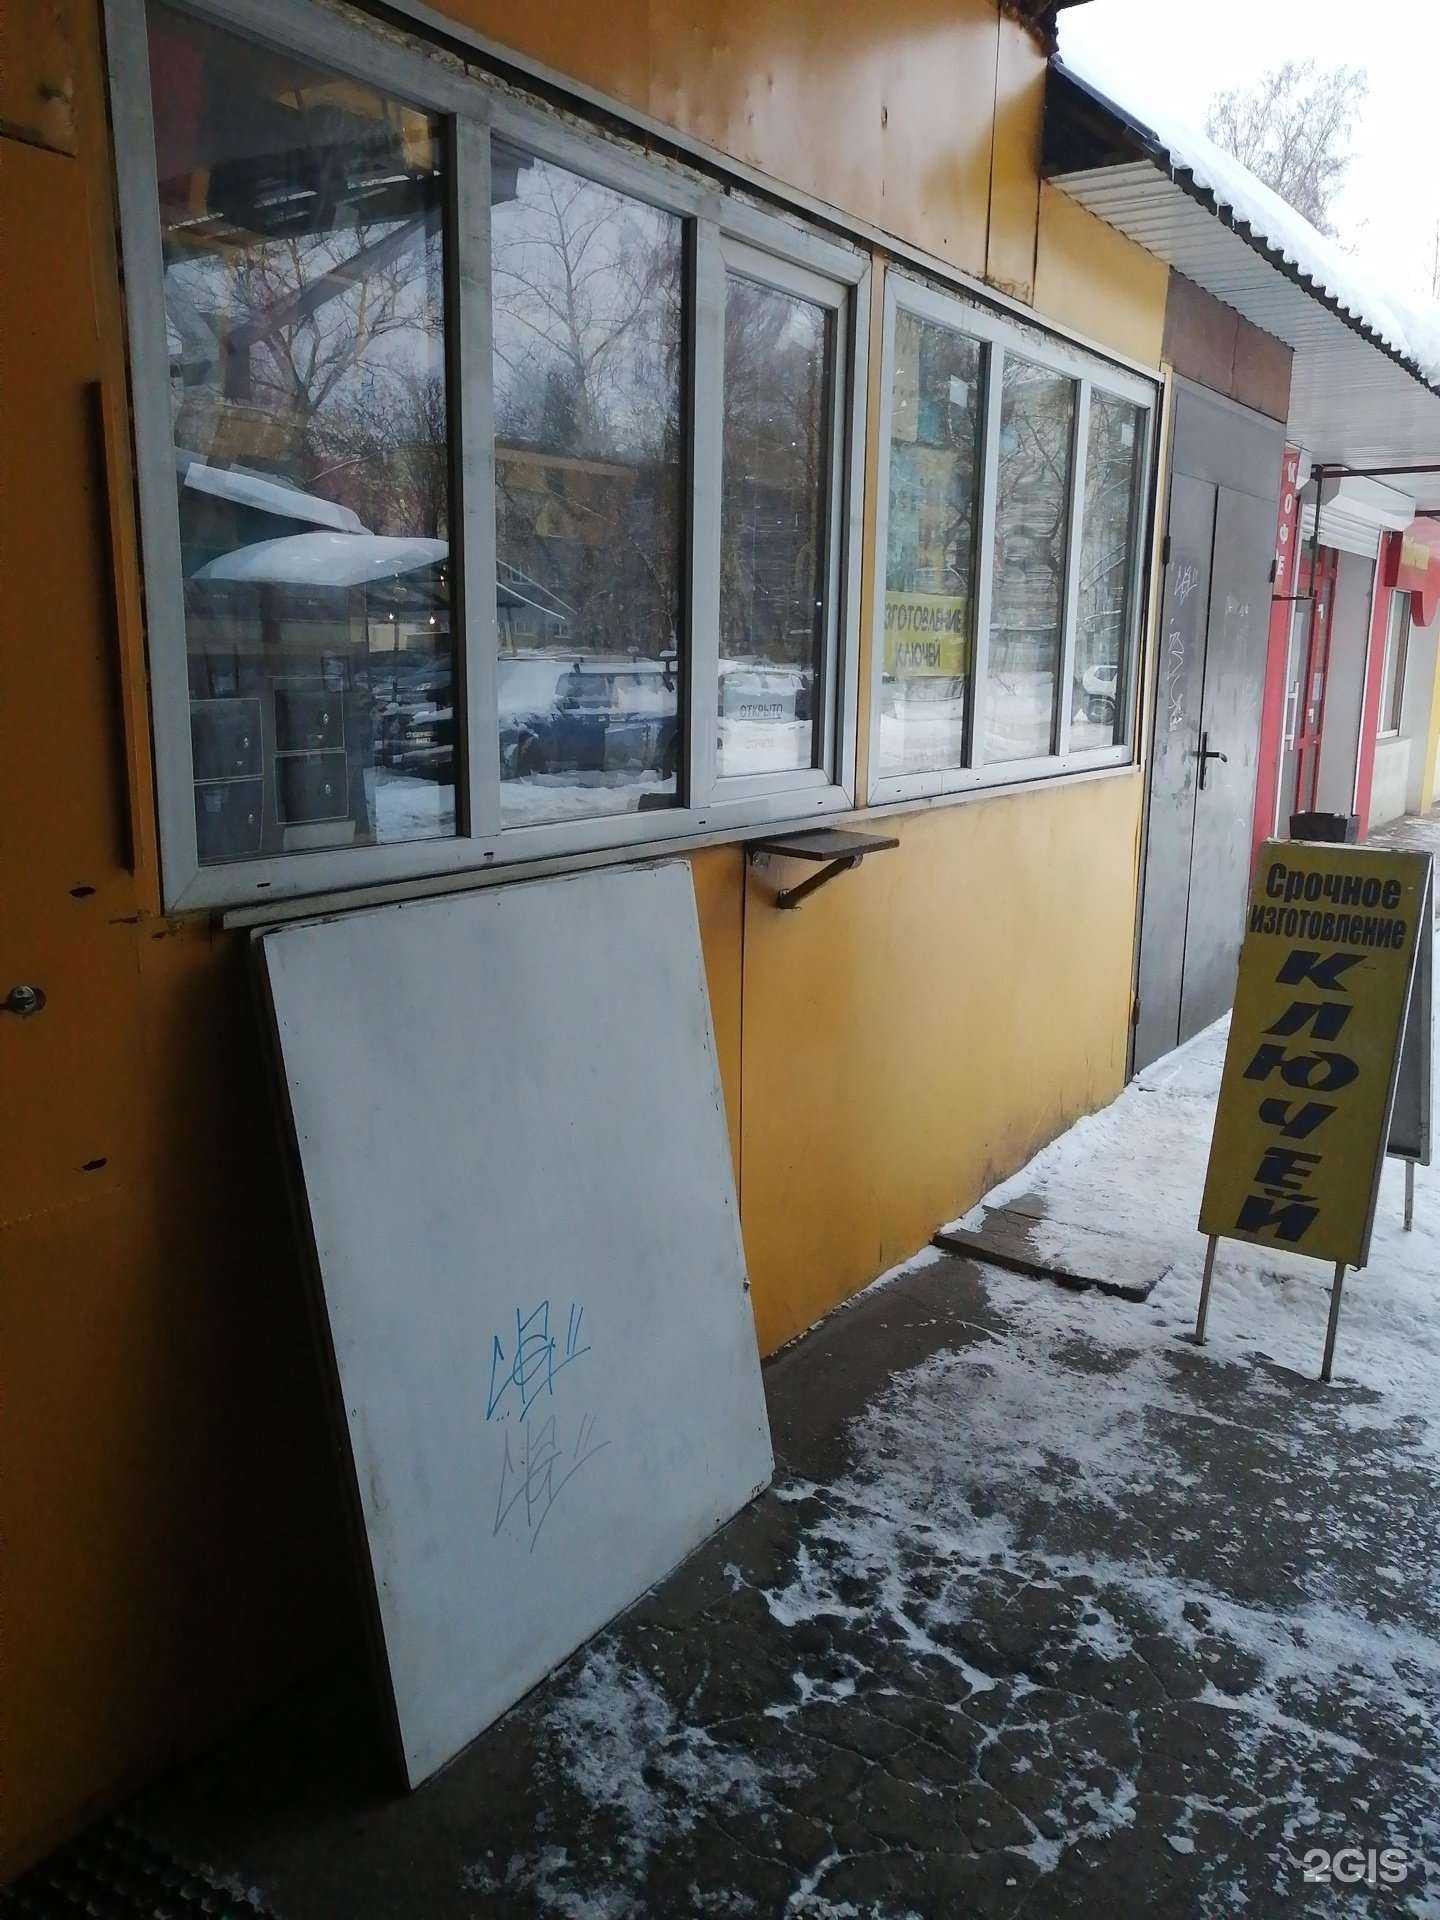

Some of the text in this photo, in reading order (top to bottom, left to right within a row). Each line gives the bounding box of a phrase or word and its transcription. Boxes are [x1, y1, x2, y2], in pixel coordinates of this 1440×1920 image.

[884, 603, 961, 632] ЗГОТОВЛЕНИЕ
[895, 638, 941, 668] КЛЮЧЕЙ
[1266, 863, 1401, 910] Срочное
[1249, 904, 1408, 950] изготовление
[1234, 949, 1368, 1243] КЛЮЧЕЙ
